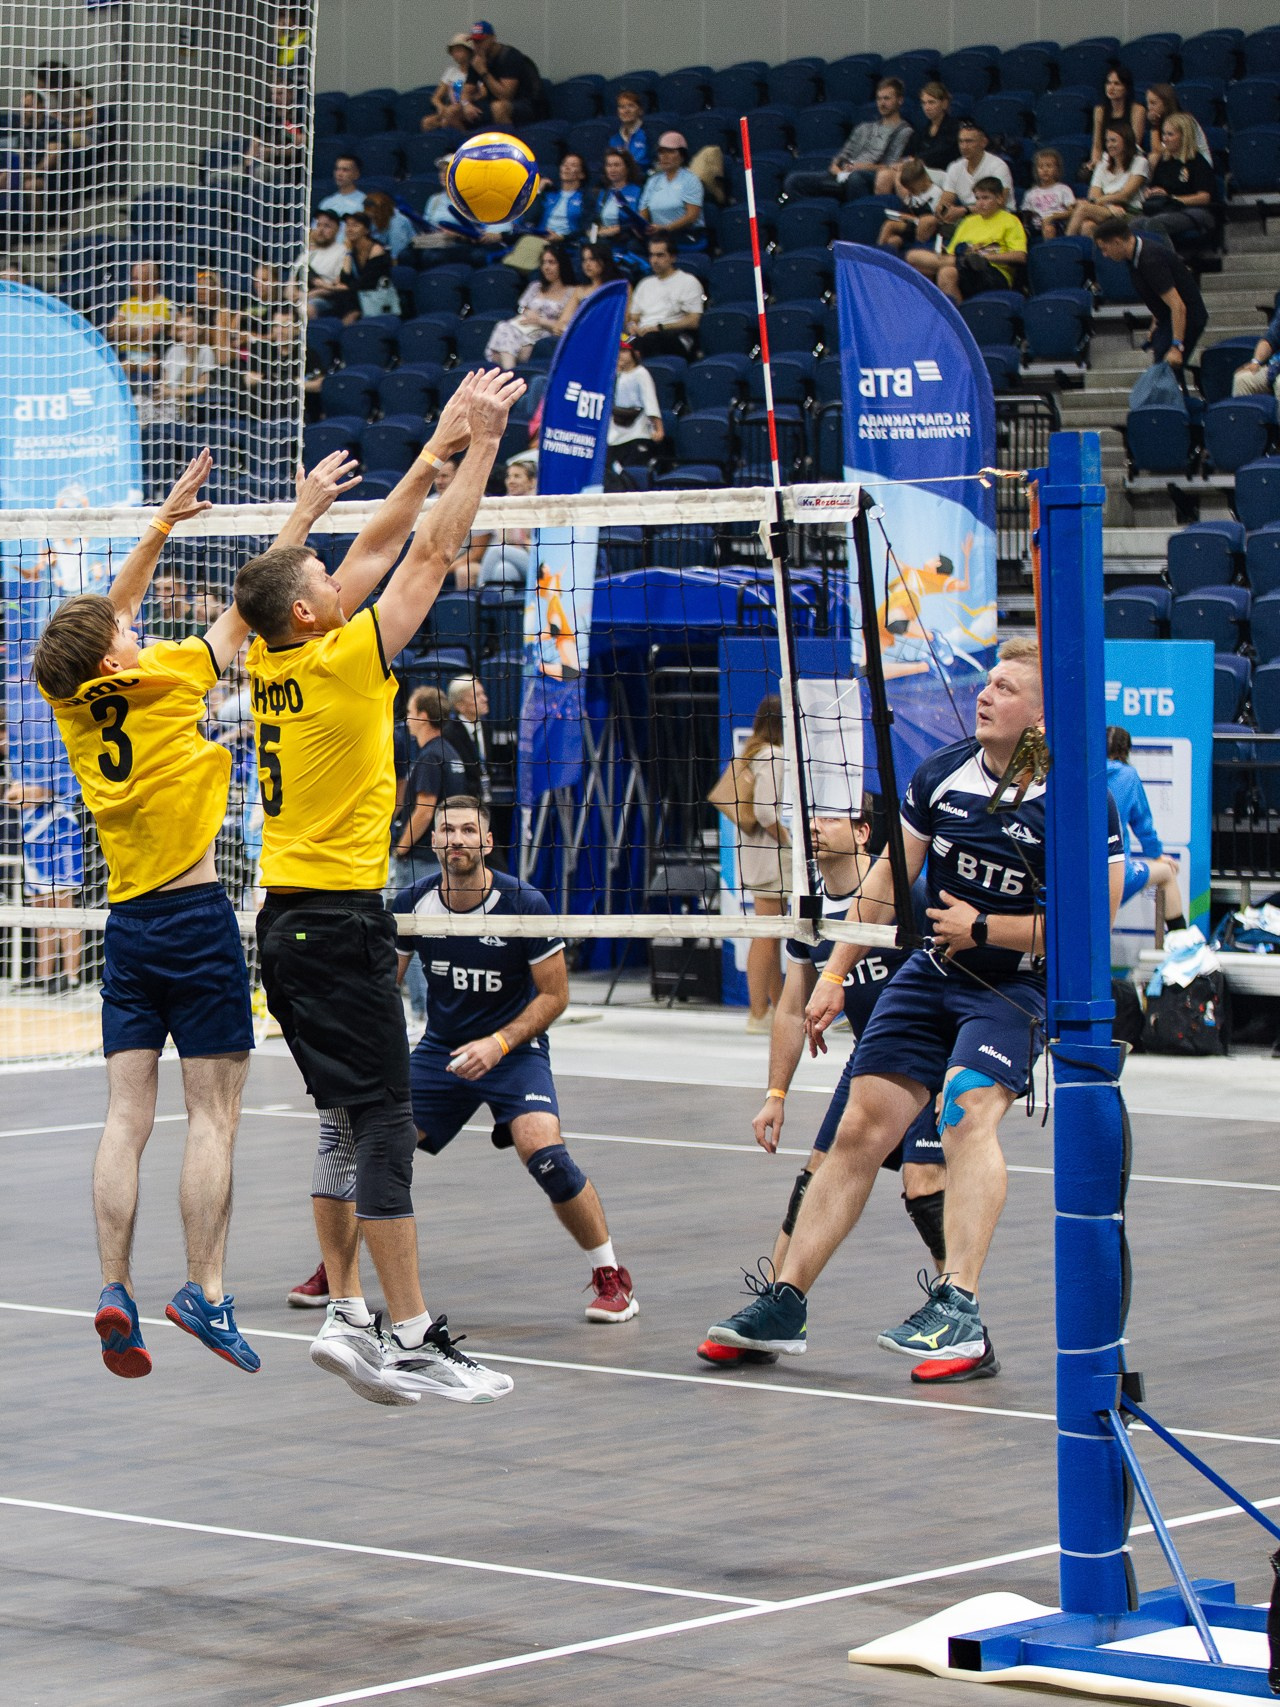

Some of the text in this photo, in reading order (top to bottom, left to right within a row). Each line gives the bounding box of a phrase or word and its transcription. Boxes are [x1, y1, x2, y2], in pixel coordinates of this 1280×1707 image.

[251, 677, 304, 716] НФО
[1123, 687, 1175, 717] ВТБ
[90, 694, 133, 783] 3
[258, 722, 283, 817] 5
[957, 851, 1026, 896] ВТБ
[452, 966, 503, 993] ВТБ
